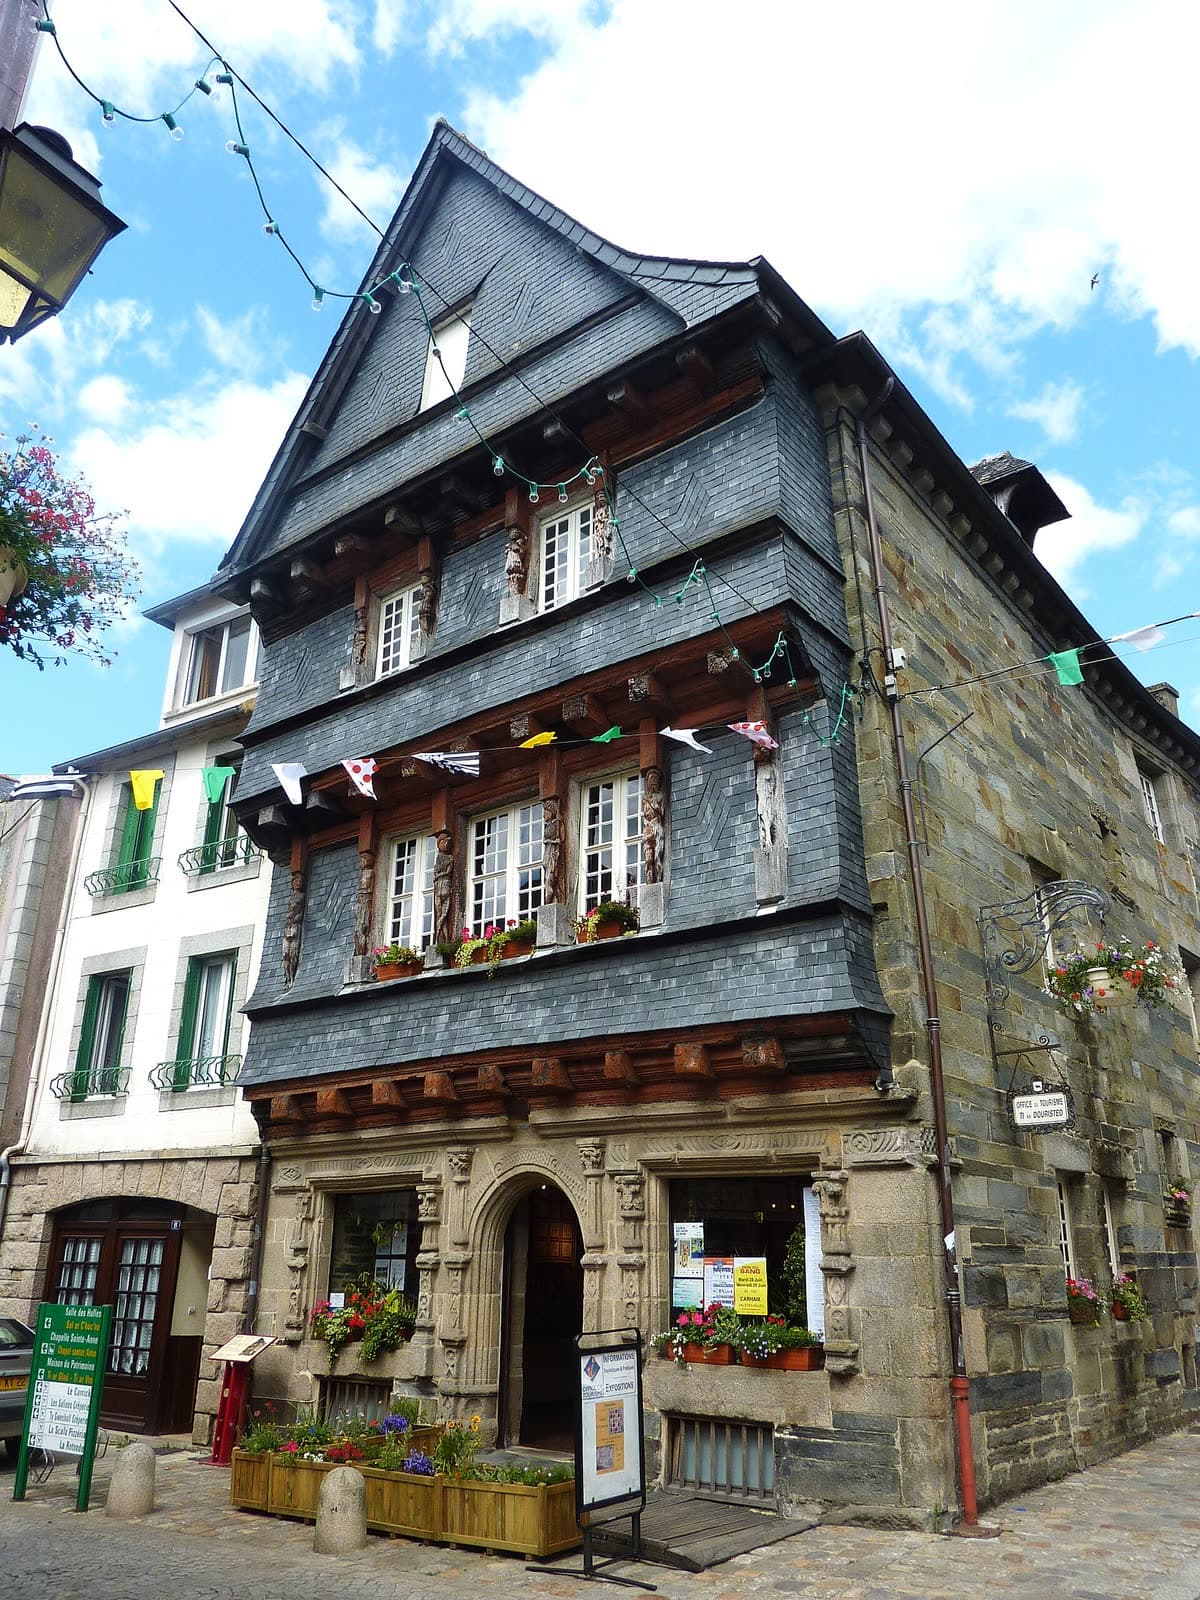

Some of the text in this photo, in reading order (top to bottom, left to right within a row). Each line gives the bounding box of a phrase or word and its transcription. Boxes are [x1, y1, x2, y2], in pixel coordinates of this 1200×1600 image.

[1016, 1100, 1032, 1108] OFFICE
[1040, 1098, 1064, 1107] TOURISME
[1033, 1109, 1063, 1118] DOURISTED
[65, 1307, 102, 1318] Salle des Halles
[51, 1332, 98, 1344] Chapelle Sainte-Anne
[603, 1353, 635, 1363] INFORMATIONS
[47, 1357, 95, 1370] Maison du Patrimoine
[67, 1387, 73, 1396] Le
[605, 1382, 633, 1392] EXPOSITIONS
[49, 1425, 53, 1434] La
[60, 1440, 64, 1449] La
